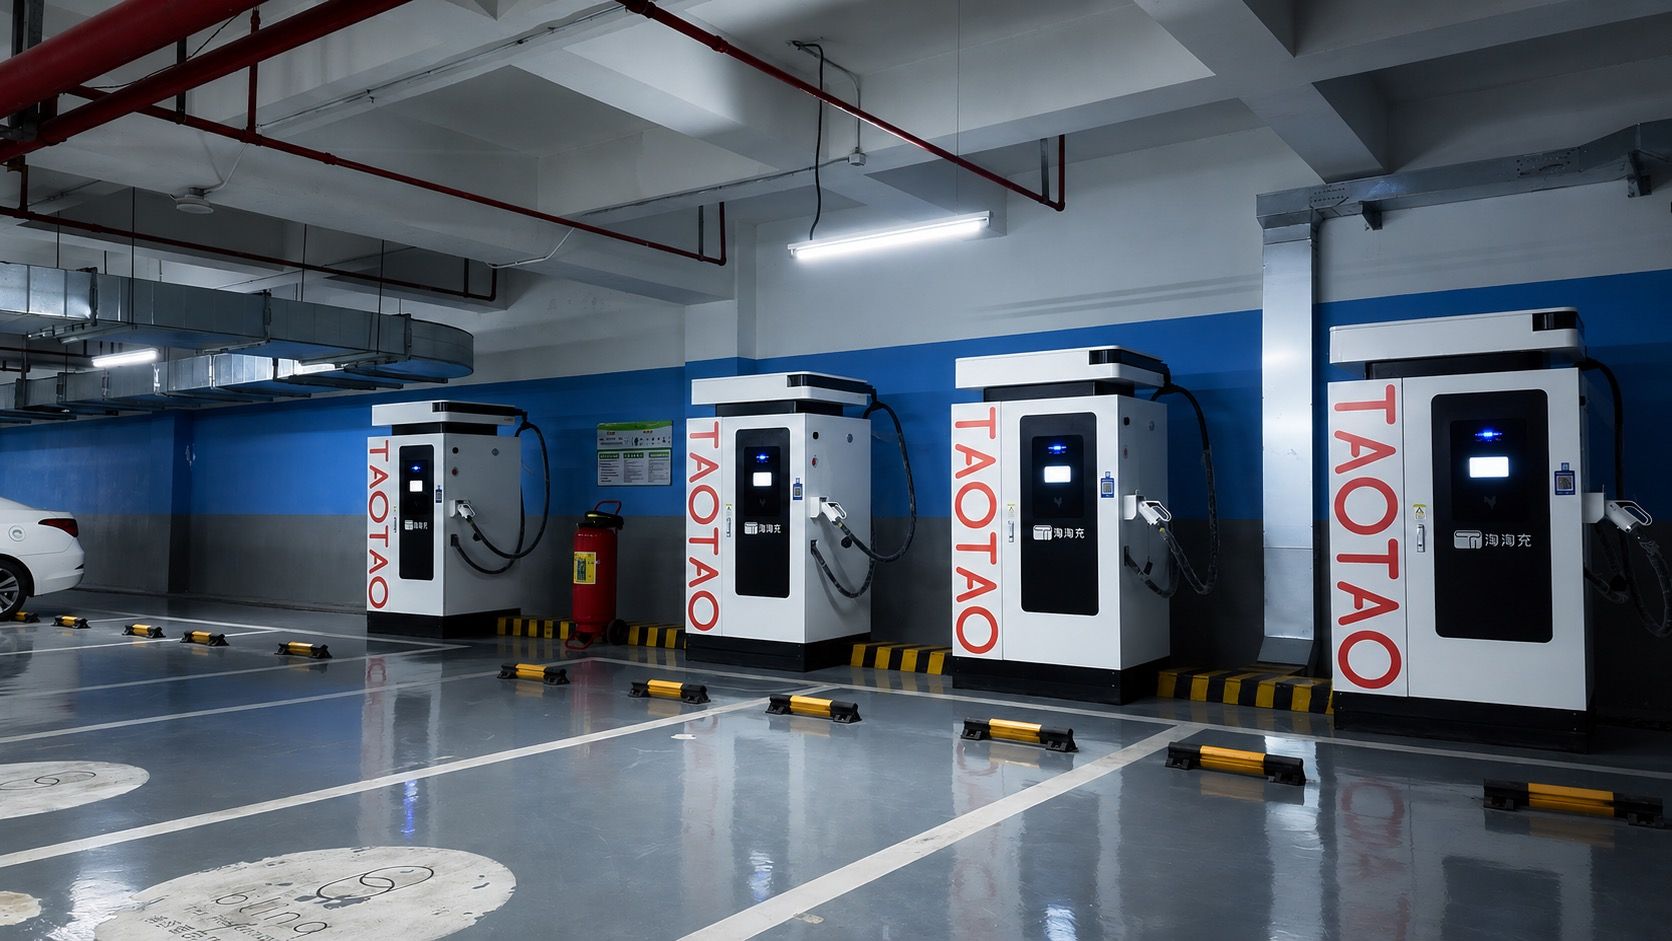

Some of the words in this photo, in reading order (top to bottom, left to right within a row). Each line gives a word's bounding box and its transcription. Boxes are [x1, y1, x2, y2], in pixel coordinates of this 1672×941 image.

[368, 440, 390, 609] TAOTAO
[687, 420, 720, 632] TAOTAO
[955, 406, 999, 655] TAOTAO
[1333, 384, 1403, 690] TAOTAO
[1485, 533, 1532, 547] 淘淘充
